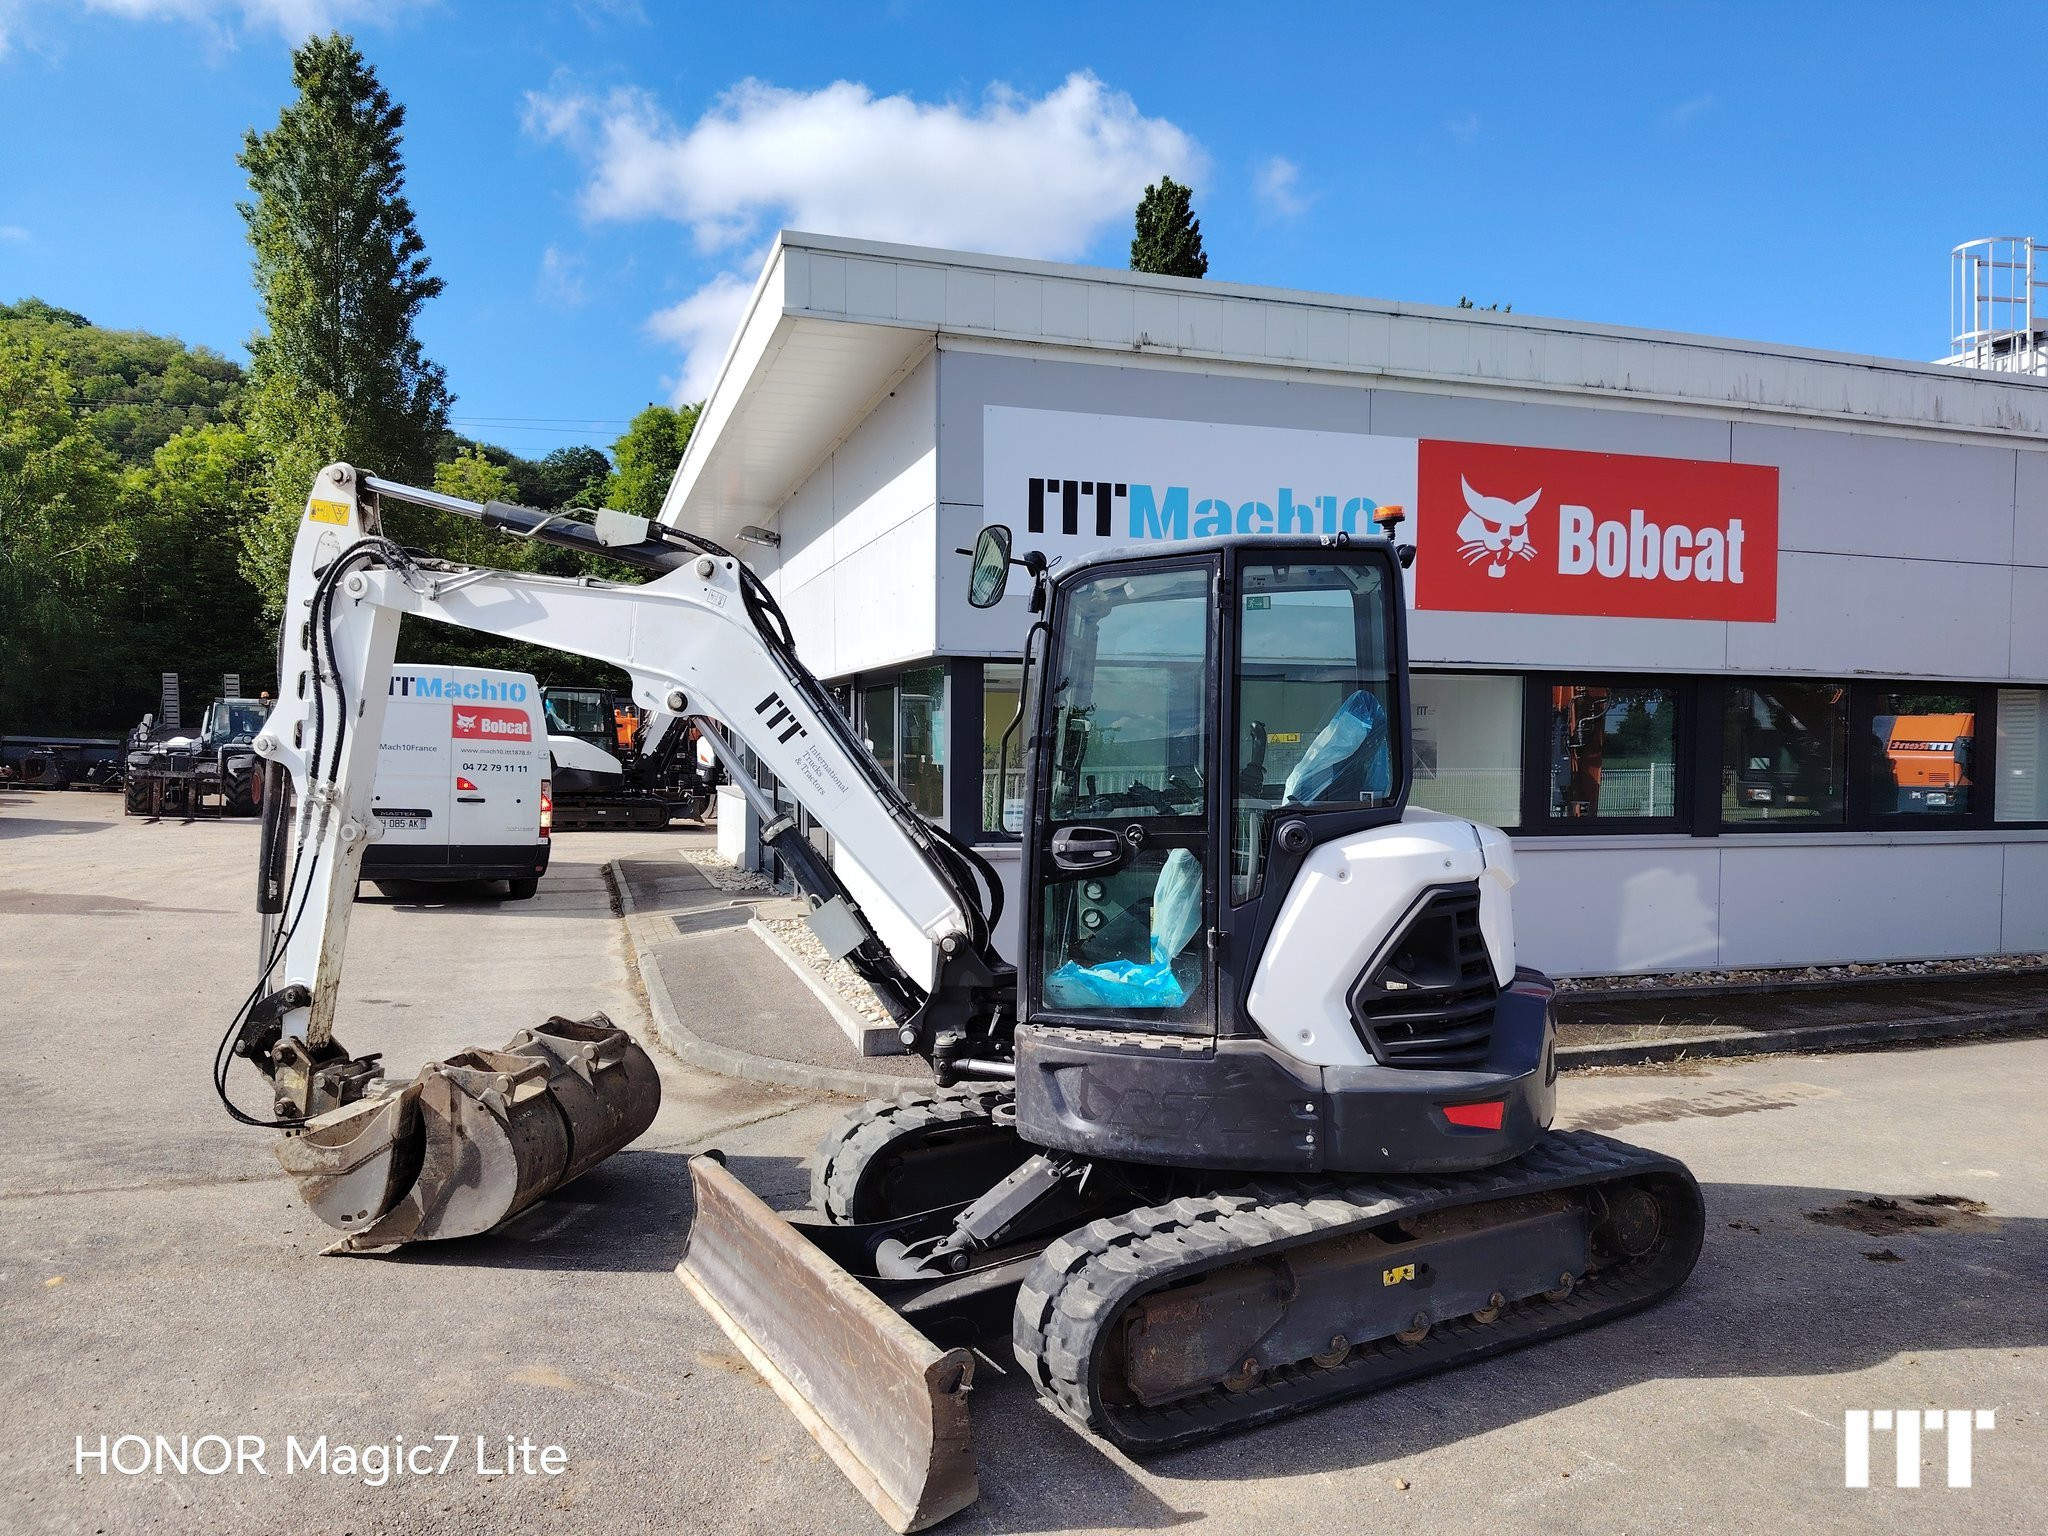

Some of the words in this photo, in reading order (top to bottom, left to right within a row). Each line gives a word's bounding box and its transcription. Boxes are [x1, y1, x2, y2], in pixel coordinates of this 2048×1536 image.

[1558, 504, 1745, 584] Bobcat
[481, 718, 528, 735] Bobcat
[379, 743, 438, 753] Mach10France
[462, 763, 474, 771] 04
[477, 763, 488, 771] 72
[491, 764, 502, 772] 79
[517, 765, 528, 773] 11
[795, 757, 802, 766] &
[801, 766, 825, 795] Tractors
[803, 751, 822, 777] Trucks
[809, 744, 848, 793] International
